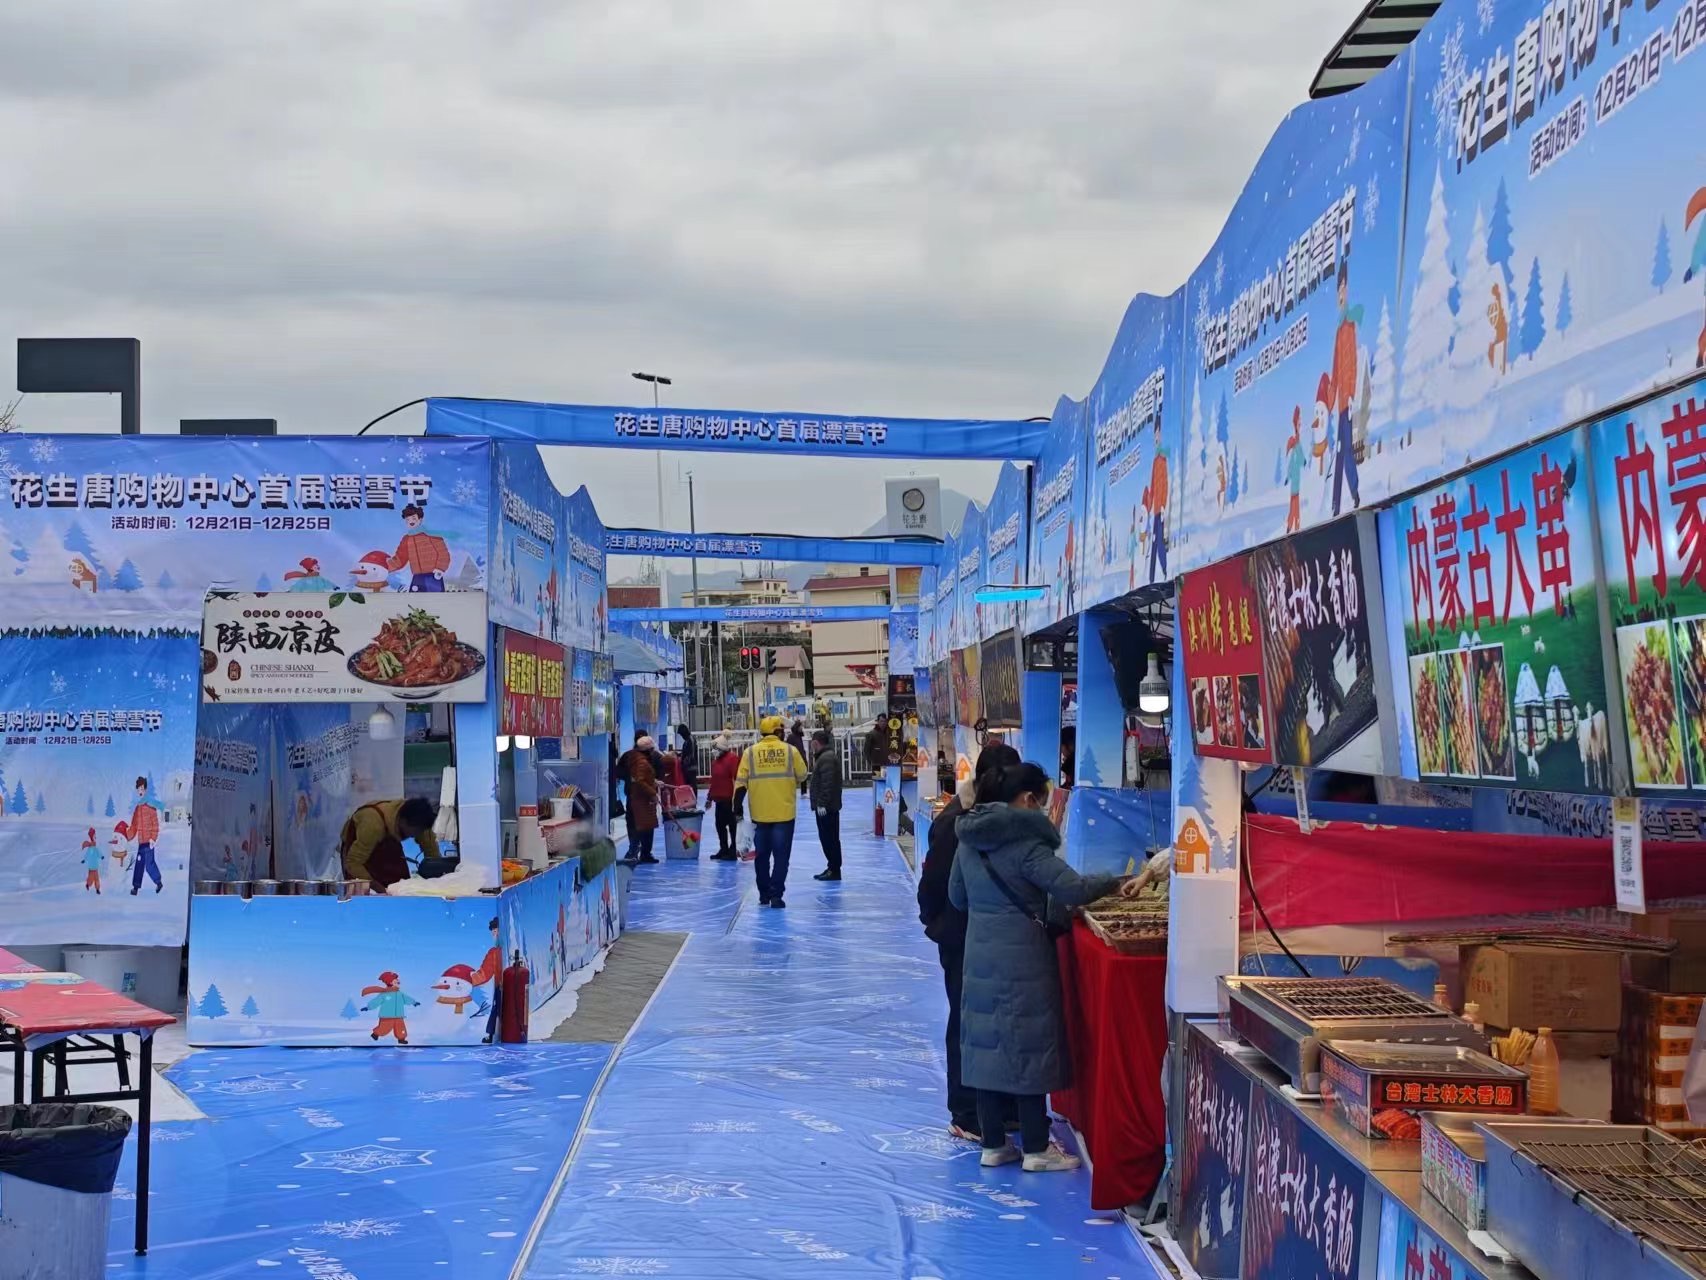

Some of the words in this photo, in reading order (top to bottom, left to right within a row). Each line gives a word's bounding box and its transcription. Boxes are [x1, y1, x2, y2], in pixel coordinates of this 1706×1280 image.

[614, 413, 888, 445] 花生唐购物中心首届漂雪节
[10, 474, 432, 510] 花生唐购物中心首届漂雪节
[1407, 452, 1572, 640] 内蒙古大串
[214, 619, 345, 656] 陕西凉皮
[1386, 1082, 1513, 1106] 台湾士林大香肠
